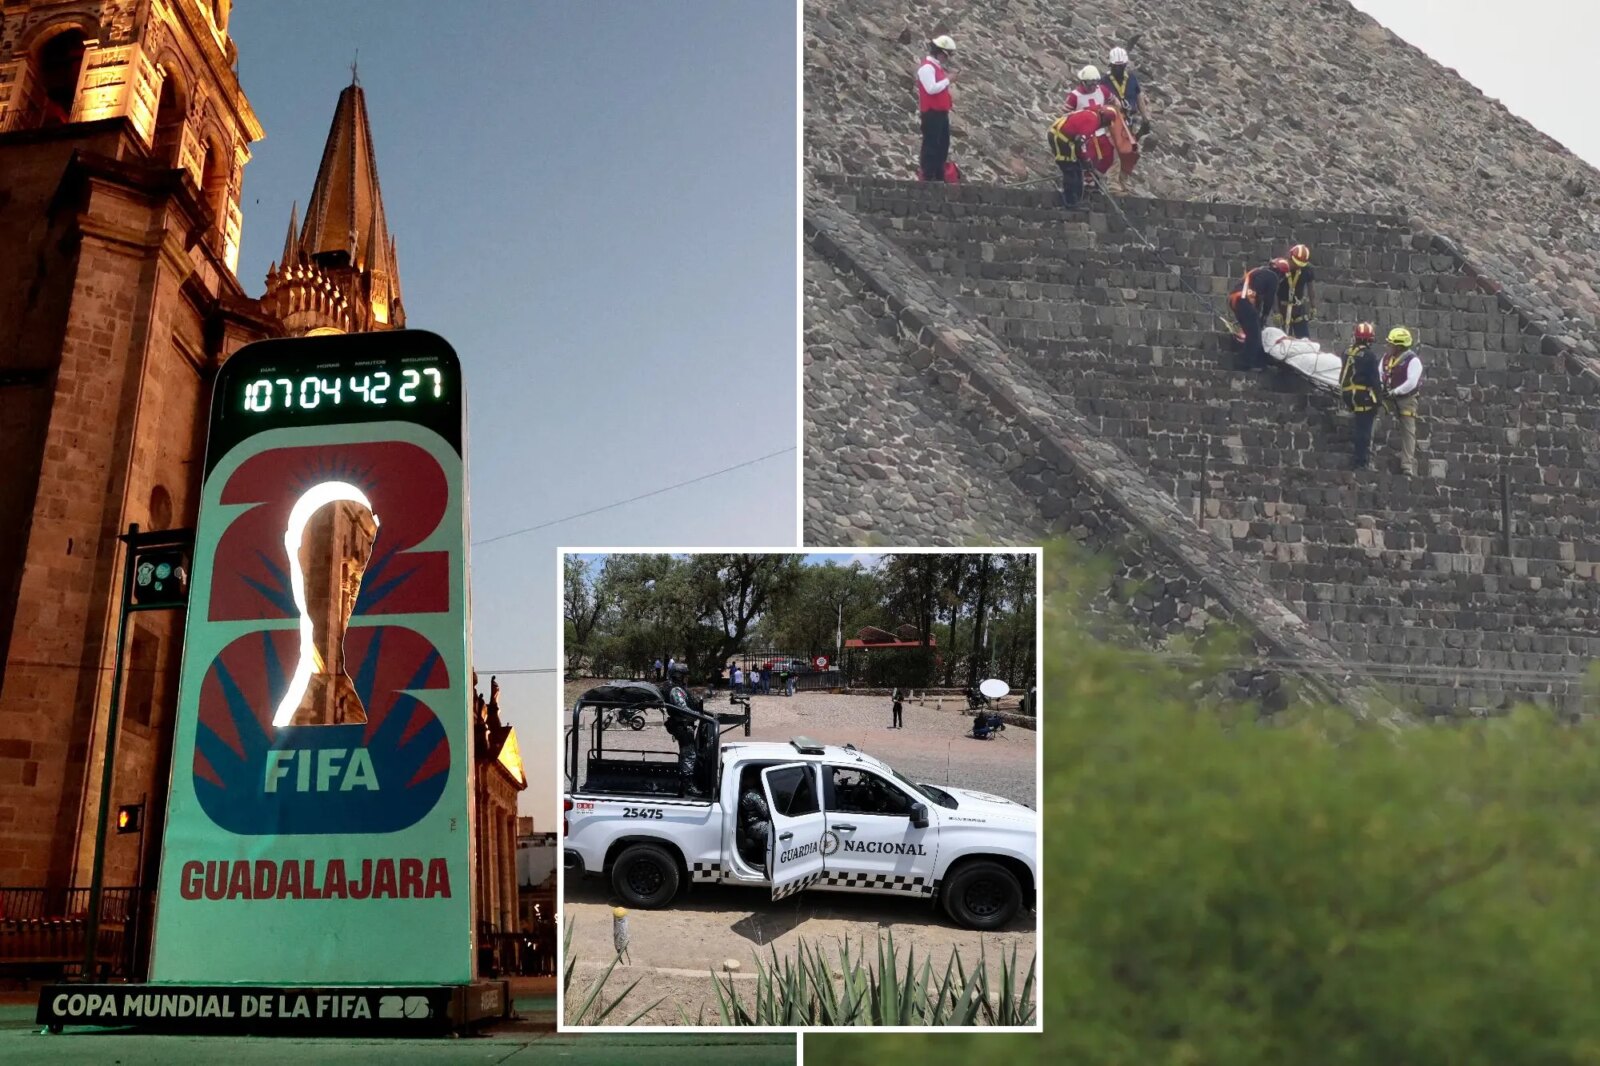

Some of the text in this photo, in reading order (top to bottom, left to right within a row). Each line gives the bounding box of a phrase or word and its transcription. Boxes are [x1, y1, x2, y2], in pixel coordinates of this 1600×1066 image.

[244, 367, 441, 412] 107 04 42 27
[264, 748, 380, 793] FIFA
[622, 807, 664, 820] 25475
[780, 840, 818, 864] GUARDIA
[844, 839, 927, 857] NACIONAL
[180, 858, 452, 900] GUADALAJARA
[52, 994, 118, 1017] COPA
[123, 994, 235, 1018] MUNDIAL
[240, 995, 274, 1018] DE
[278, 995, 311, 1018] LA
[316, 995, 372, 1019] FIFA
